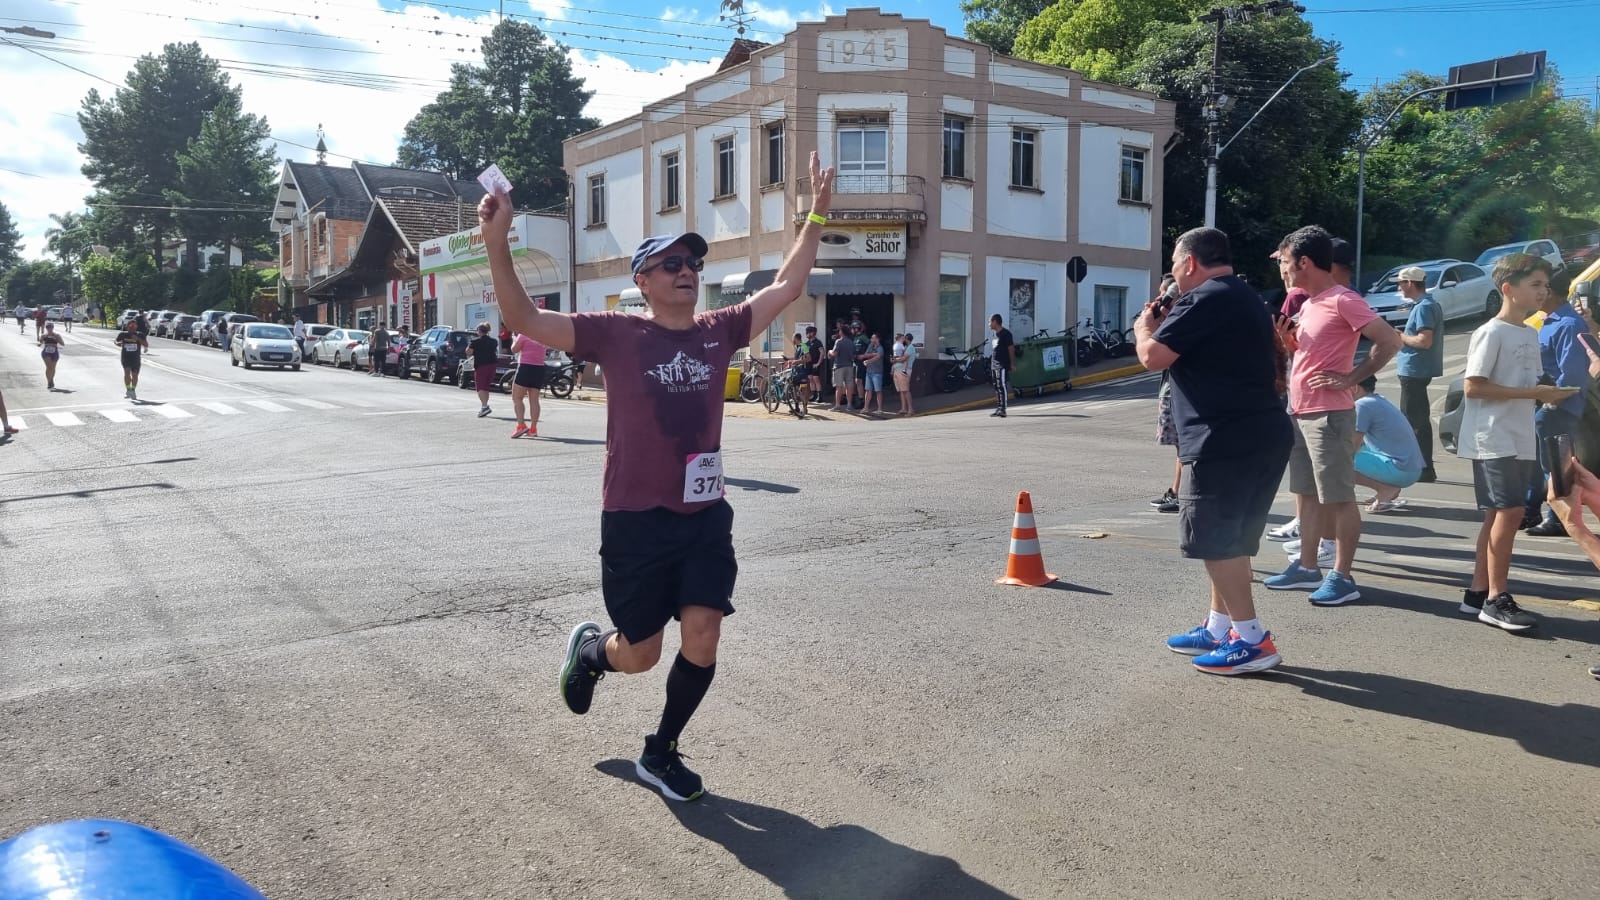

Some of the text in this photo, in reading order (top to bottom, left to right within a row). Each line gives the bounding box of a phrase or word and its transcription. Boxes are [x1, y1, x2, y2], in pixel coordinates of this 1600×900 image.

[826, 38, 896, 65] 1945
[865, 239, 901, 253] Sabor
[1226, 649, 1249, 663] FILA
